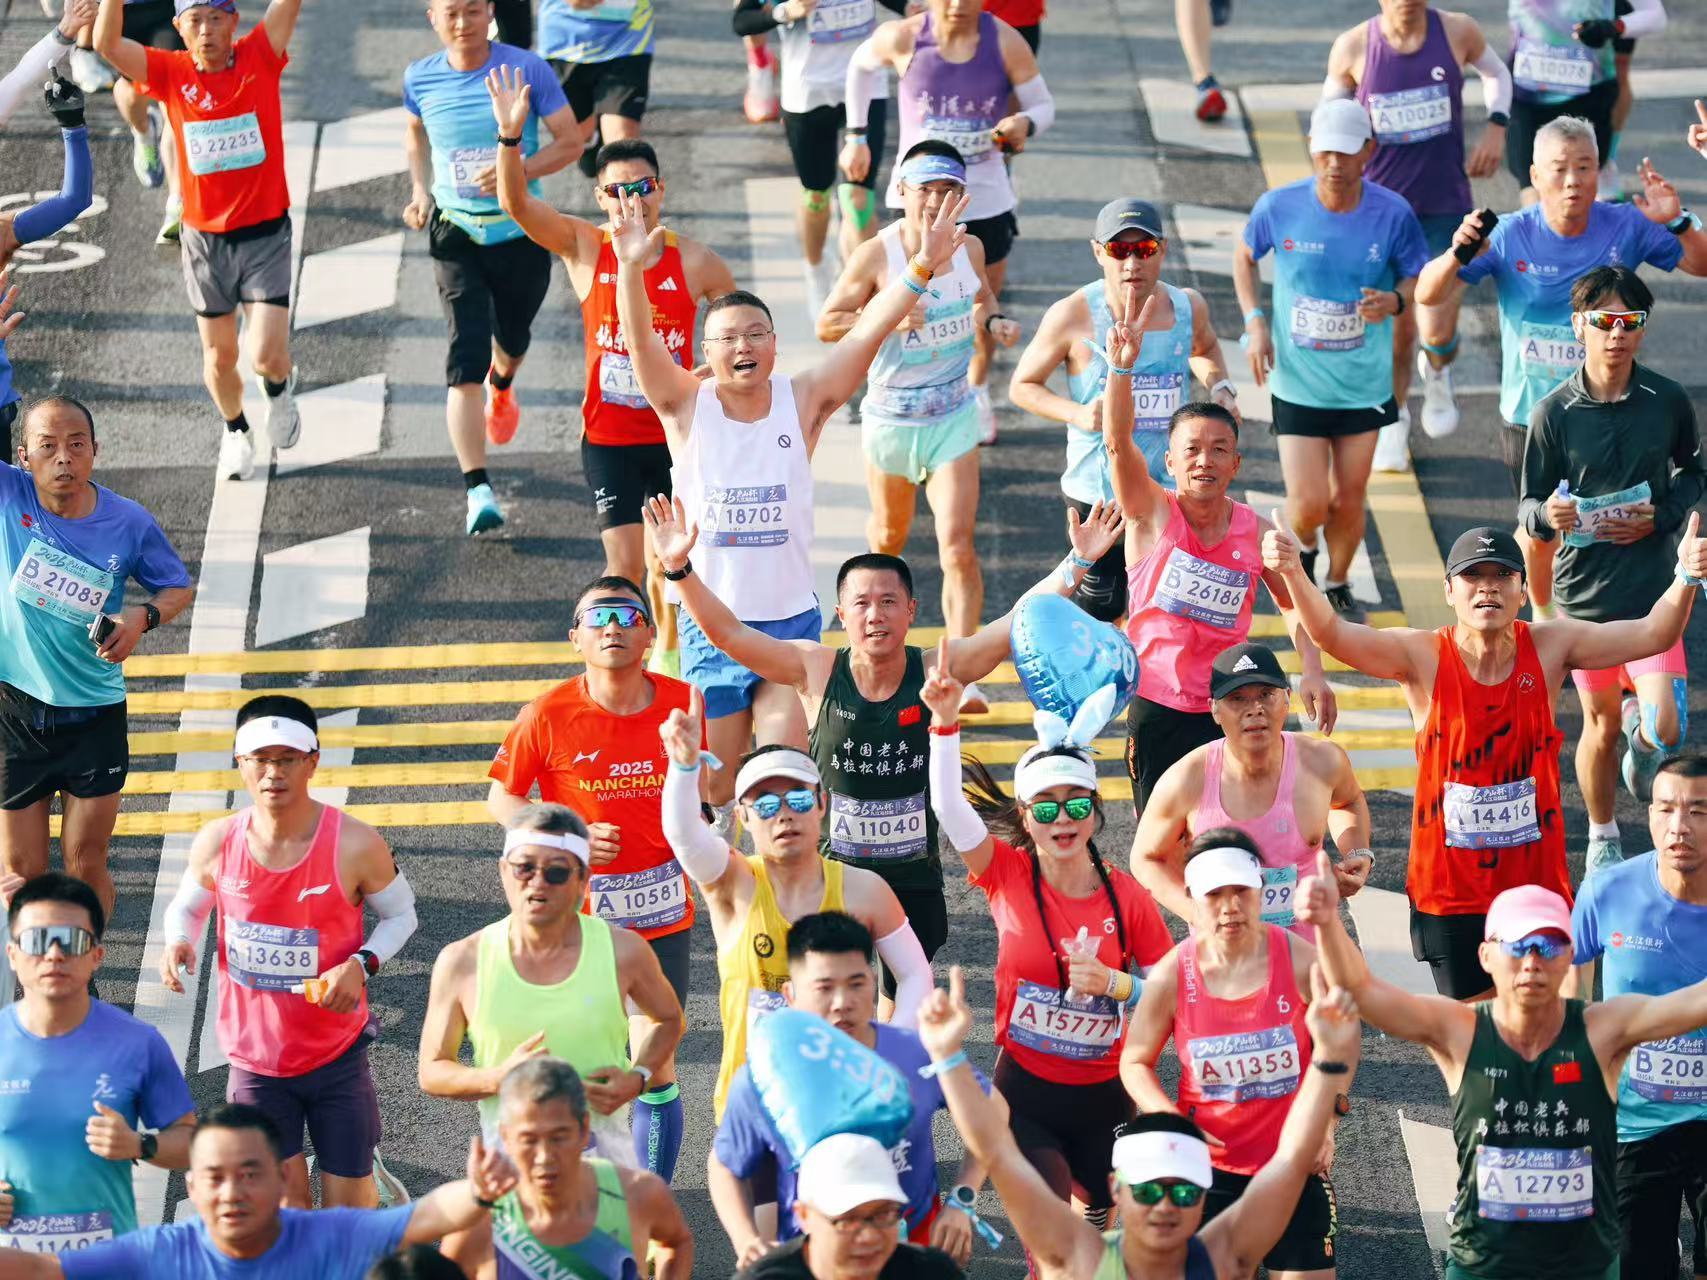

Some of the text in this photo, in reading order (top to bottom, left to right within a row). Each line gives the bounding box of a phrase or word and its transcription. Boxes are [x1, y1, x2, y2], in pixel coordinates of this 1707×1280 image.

[1379, 110, 1392, 128] A
[190, 130, 258, 155] B 22235
[455, 164, 467, 181] B
[906, 316, 971, 344] A 13311
[1296, 311, 1308, 328] B
[1526, 340, 1539, 357] A
[605, 369, 618, 386] A
[703, 503, 783, 525] A 18702
[21, 557, 104, 607] B 21083
[1164, 567, 1241, 607] B 26186
[1071, 620, 1137, 683] 3:30
[835, 708, 856, 721] 14930
[842, 737, 909, 758] 中国老兵
[609, 760, 654, 777] 2025
[830, 754, 924, 776] 马拉松俱乐部
[838, 799, 869, 817] 2026
[1448, 800, 1531, 826] A 14416
[834, 815, 920, 837] A 11040
[599, 874, 633, 892] 2026
[595, 880, 680, 913] A 10581
[1265, 886, 1291, 906] 99
[246, 947, 312, 968] 13638
[1183, 955, 1197, 1003] FLIPBELT
[1018, 1002, 1113, 1039] A 15777
[800, 1025, 897, 1104] 3:30
[1202, 1050, 1294, 1080] A 11353
[1636, 1049, 1705, 1078] B 208
[1494, 1097, 1569, 1118] 中国老兵
[1475, 1117, 1591, 1137] 马拉松俱乐部
[1483, 1170, 1585, 1195] A 12793
[8, 1215, 48, 1234] 2026
